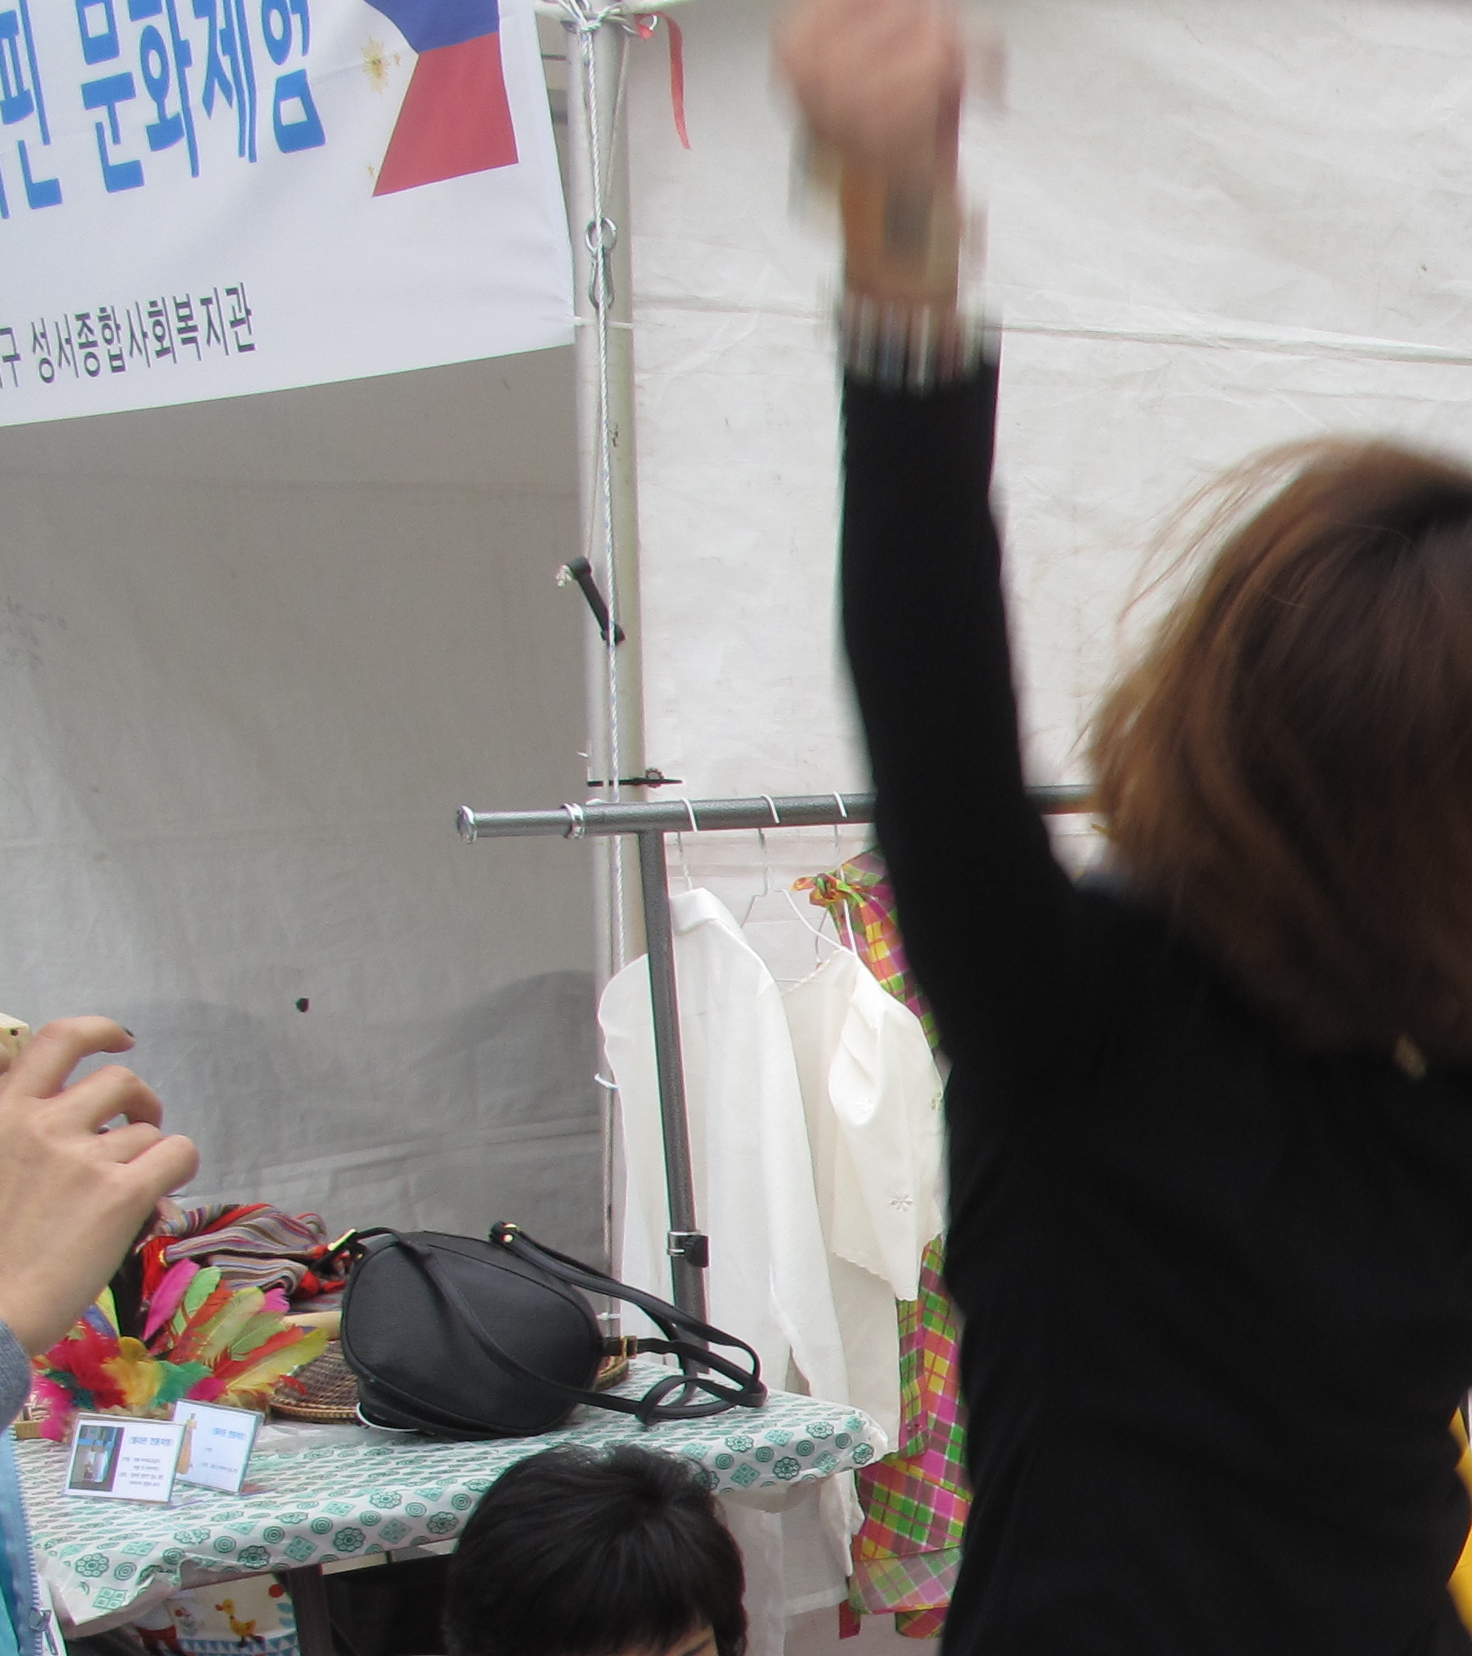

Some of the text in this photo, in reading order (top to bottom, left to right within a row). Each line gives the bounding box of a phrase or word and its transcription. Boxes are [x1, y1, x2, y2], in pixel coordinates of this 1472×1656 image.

[0, 0, 63, 218] 핀
[0, 282, 256, 389] 구 성서종합사회복지관
